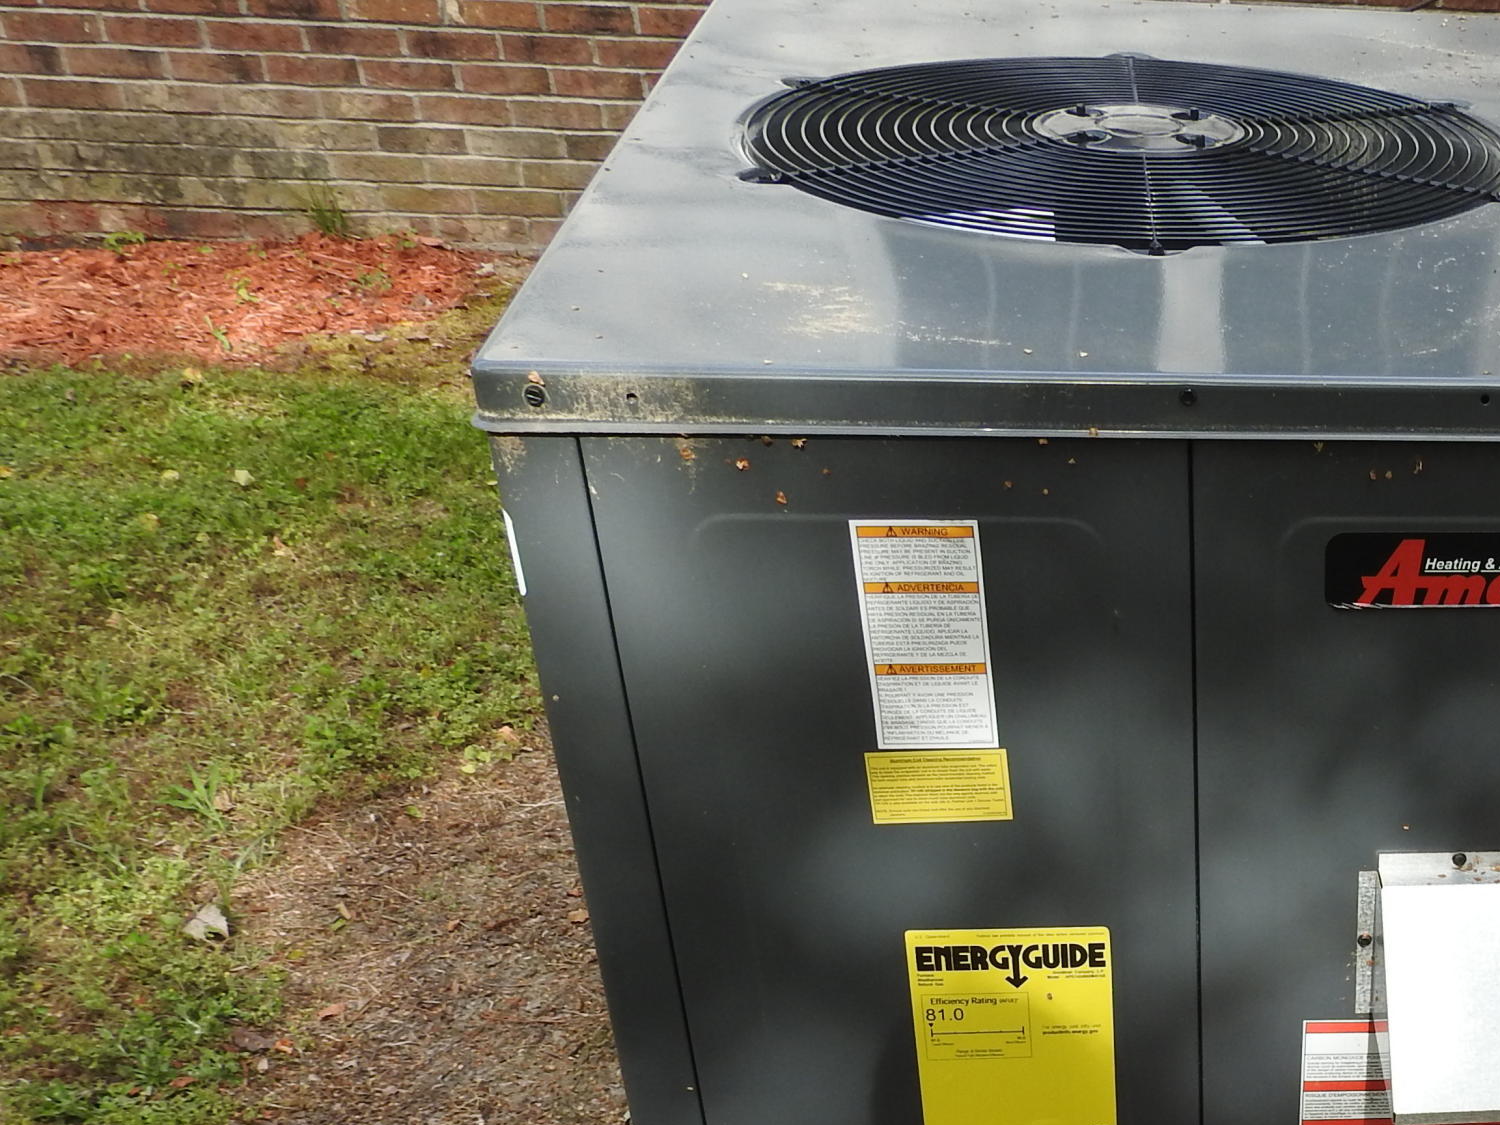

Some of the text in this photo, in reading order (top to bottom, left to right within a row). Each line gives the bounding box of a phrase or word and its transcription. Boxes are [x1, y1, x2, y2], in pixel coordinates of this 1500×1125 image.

[1425, 558, 1480, 573] Heating
[1484, 558, 1496, 570] &
[915, 943, 1106, 974] ENERGYGUIDE
[930, 998, 969, 1006] Efficiency
[926, 1008, 964, 1021] 81.0
